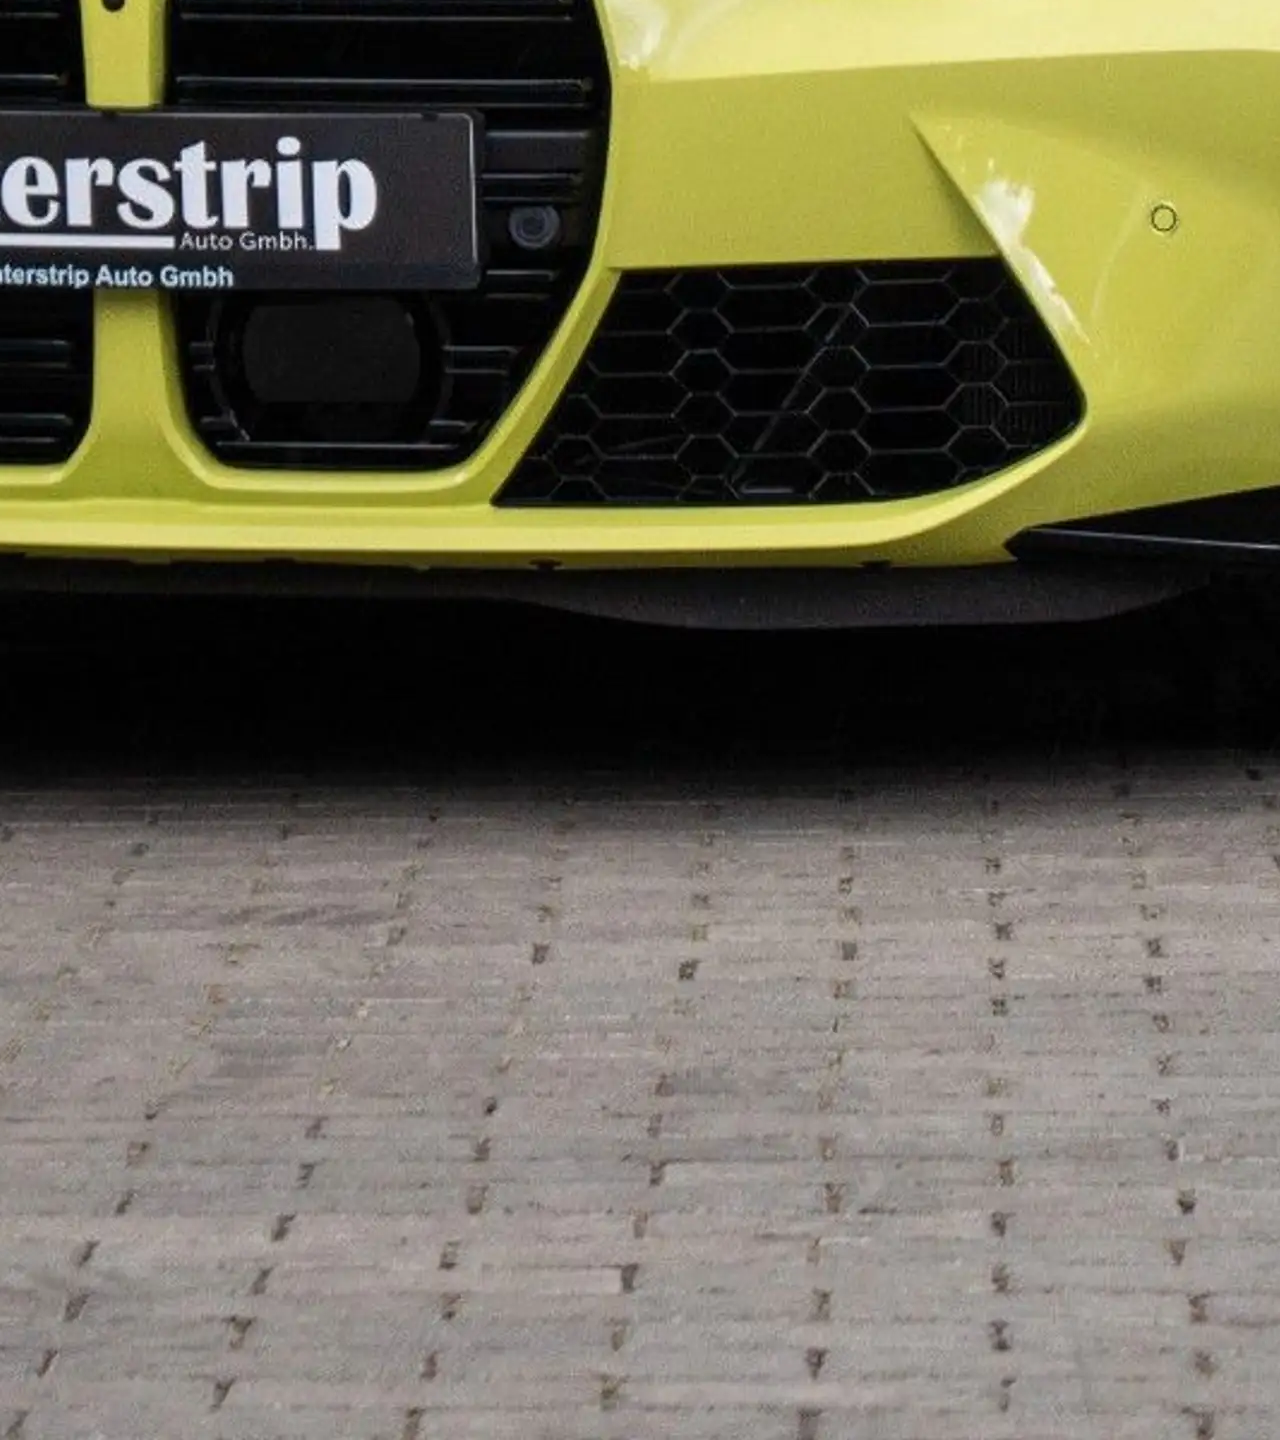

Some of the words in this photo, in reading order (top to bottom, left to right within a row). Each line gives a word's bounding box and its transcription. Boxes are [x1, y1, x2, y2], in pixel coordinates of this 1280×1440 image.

[179, 231, 234, 251] Auto
[238, 230, 314, 251] Gmbh.
[95, 264, 154, 287] Auto
[159, 265, 234, 288] Gmbh
